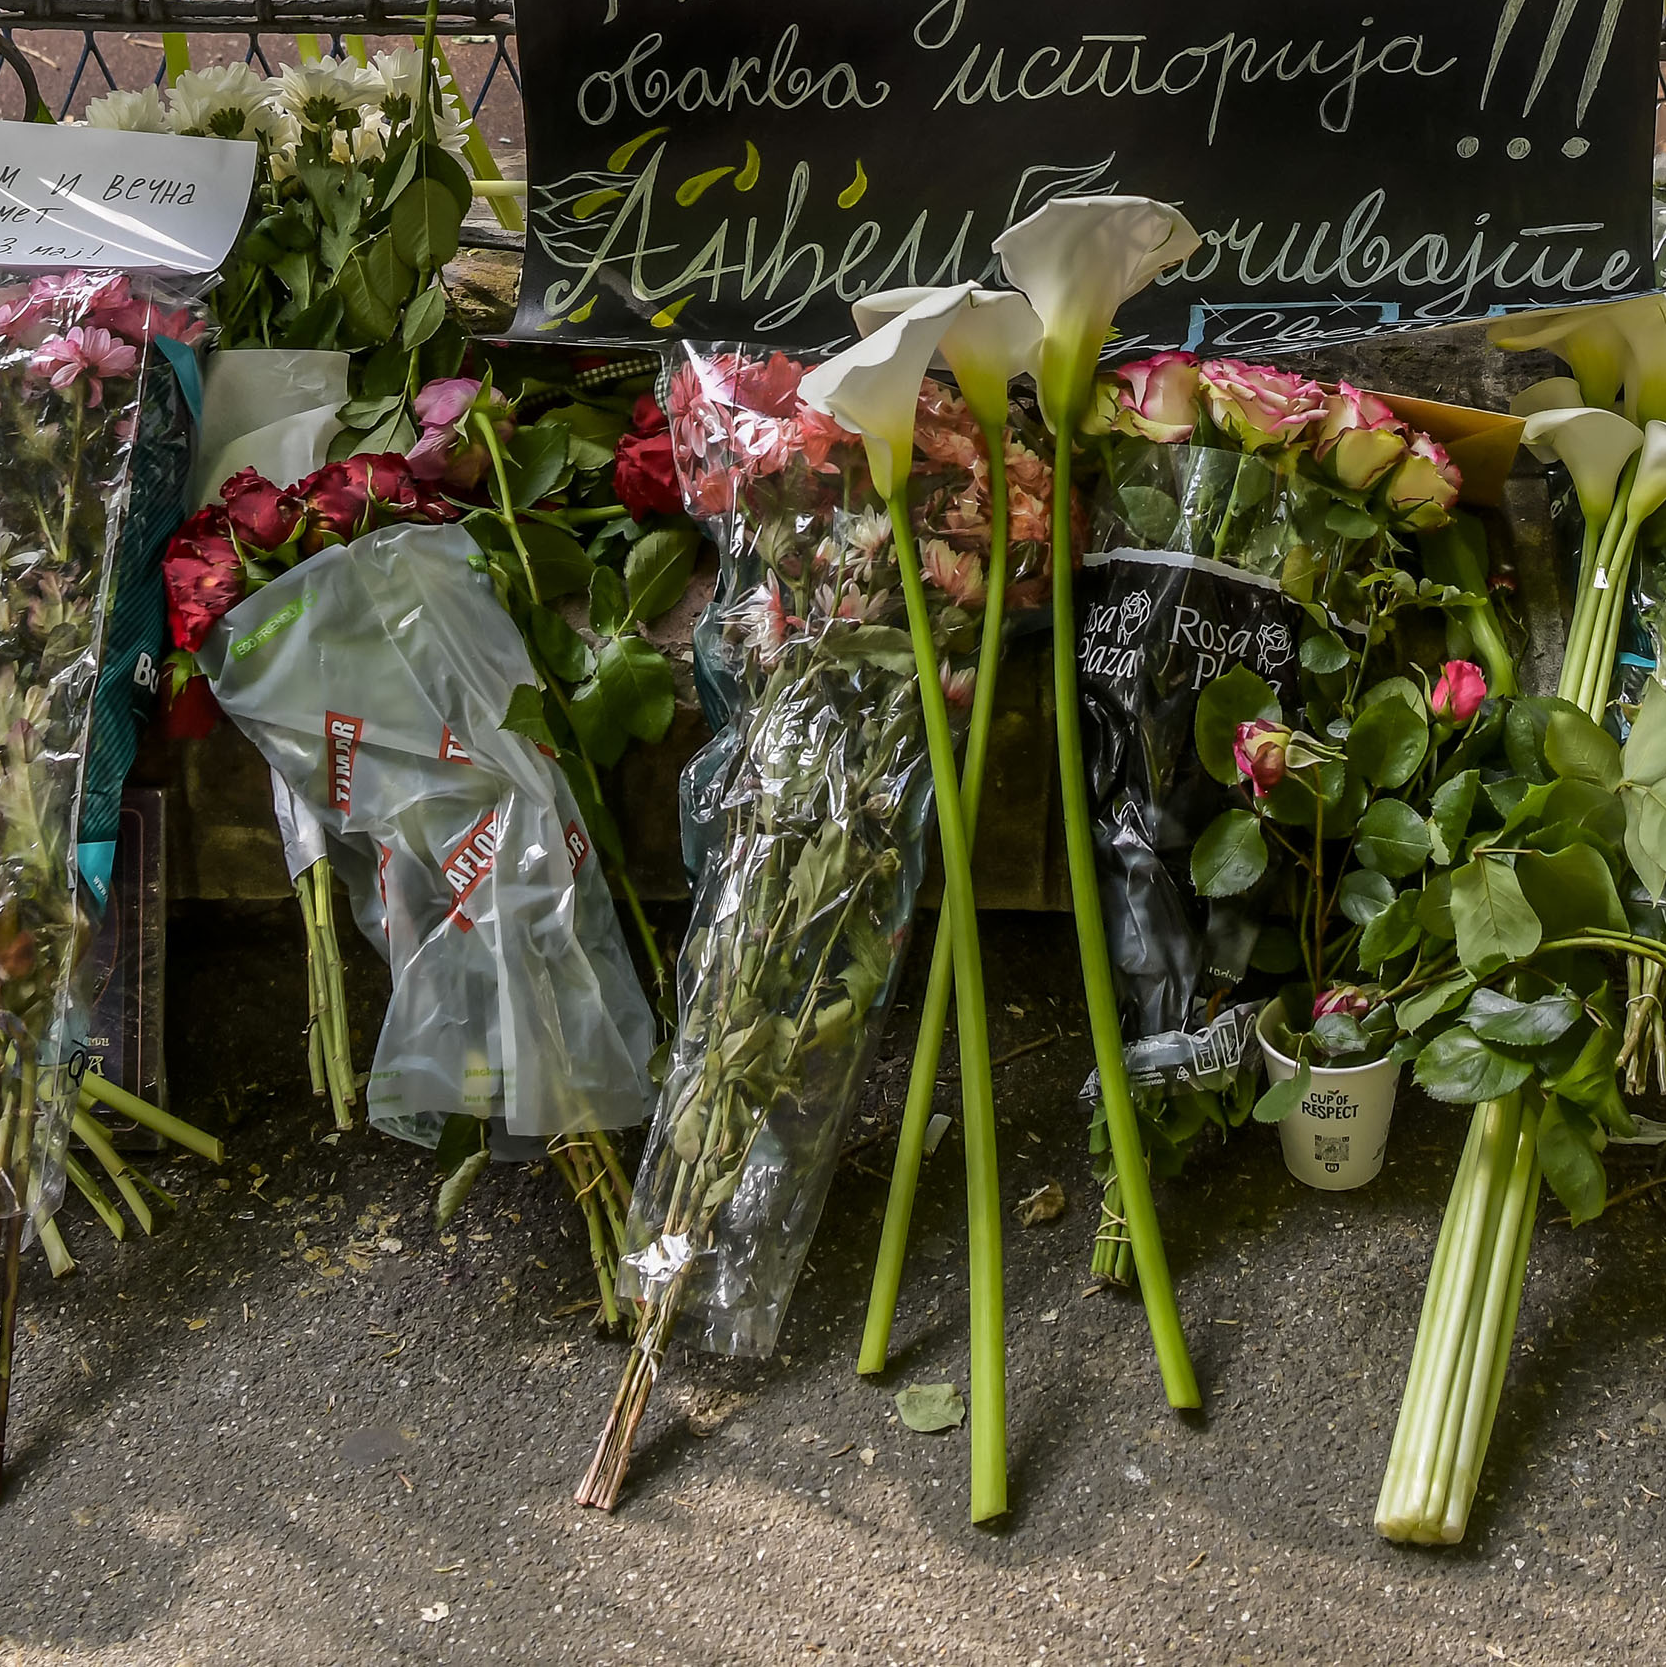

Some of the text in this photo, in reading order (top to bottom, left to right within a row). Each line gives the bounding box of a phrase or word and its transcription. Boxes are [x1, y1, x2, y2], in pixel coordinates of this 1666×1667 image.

[577, 24, 890, 125] оваква
[933, 16, 1457, 146] историја
[102, 174, 197, 205] вечна
[1151, 188, 1641, 317] очивајте
[1168, 605, 1253, 657] Rosa
[1301, 1101, 1359, 1120] RESPECT
[1310, 1092, 1349, 1106] CUP OF
